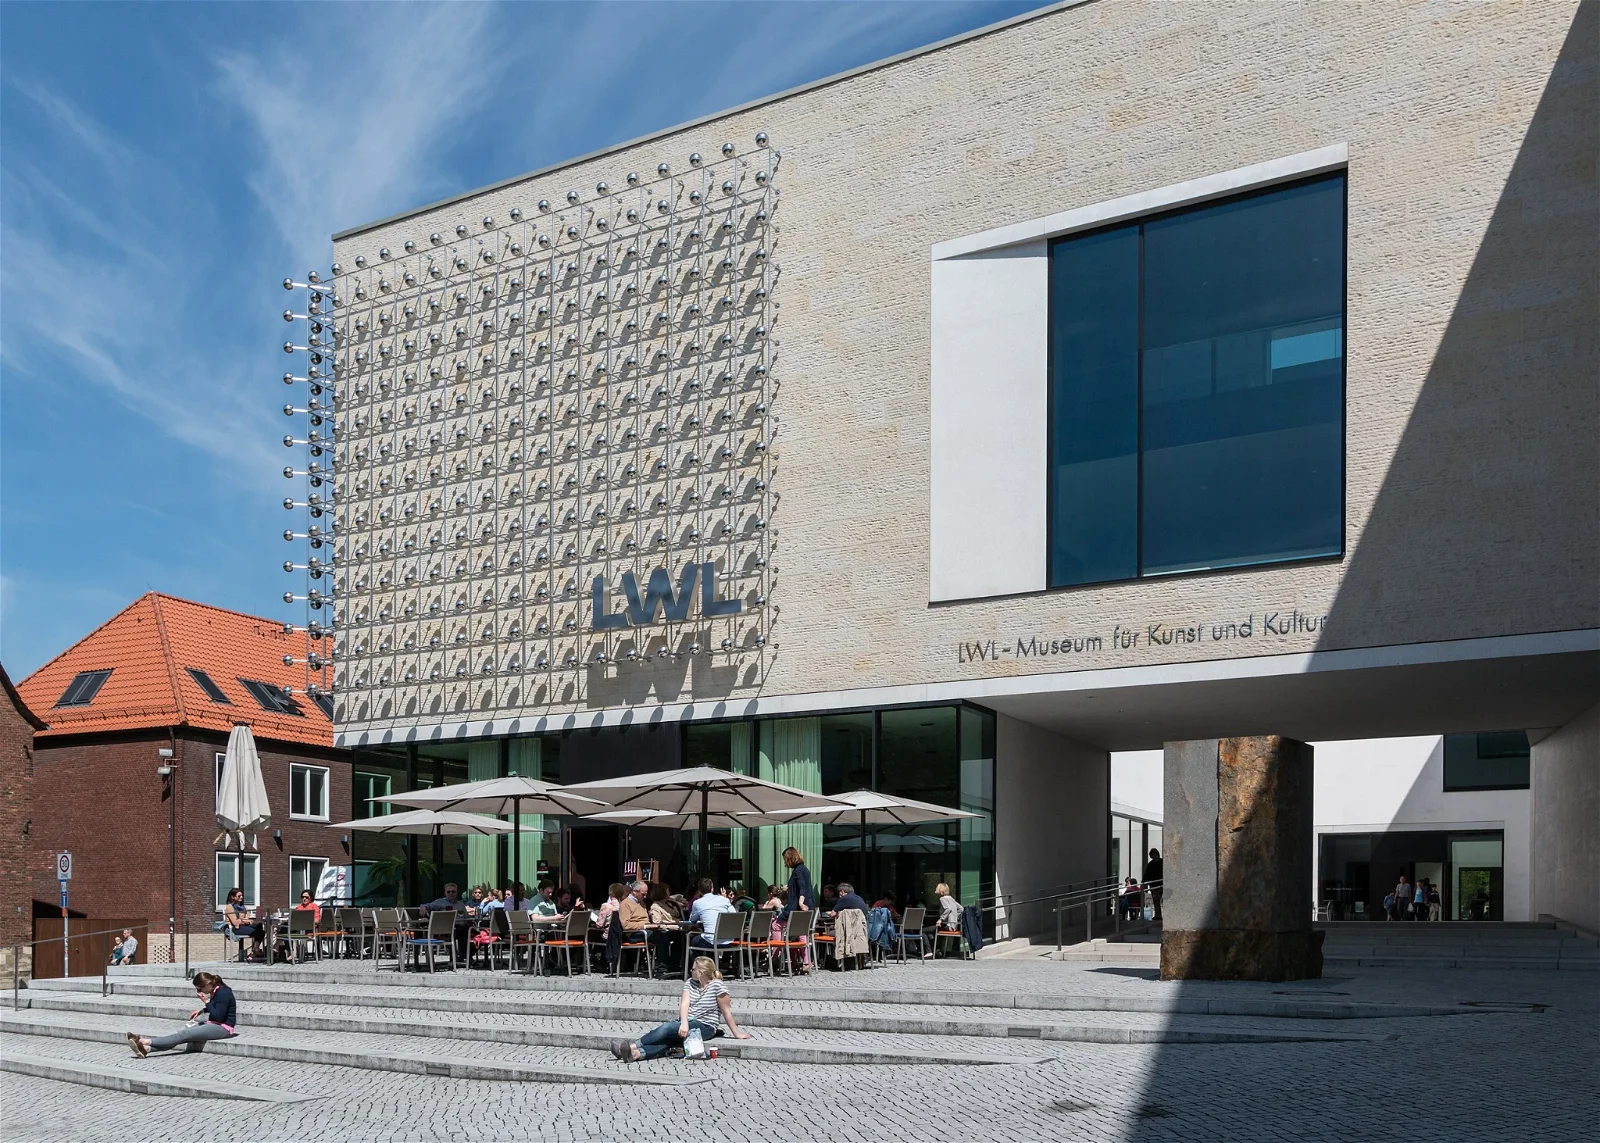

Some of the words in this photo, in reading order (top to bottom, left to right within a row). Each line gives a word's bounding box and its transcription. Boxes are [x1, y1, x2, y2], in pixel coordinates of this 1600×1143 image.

[592, 561, 745, 631] LWL
[1113, 625, 1140, 649] für
[1148, 622, 1203, 647] Kunst
[1212, 612, 1253, 641] und
[1263, 608, 1328, 637] Kultur
